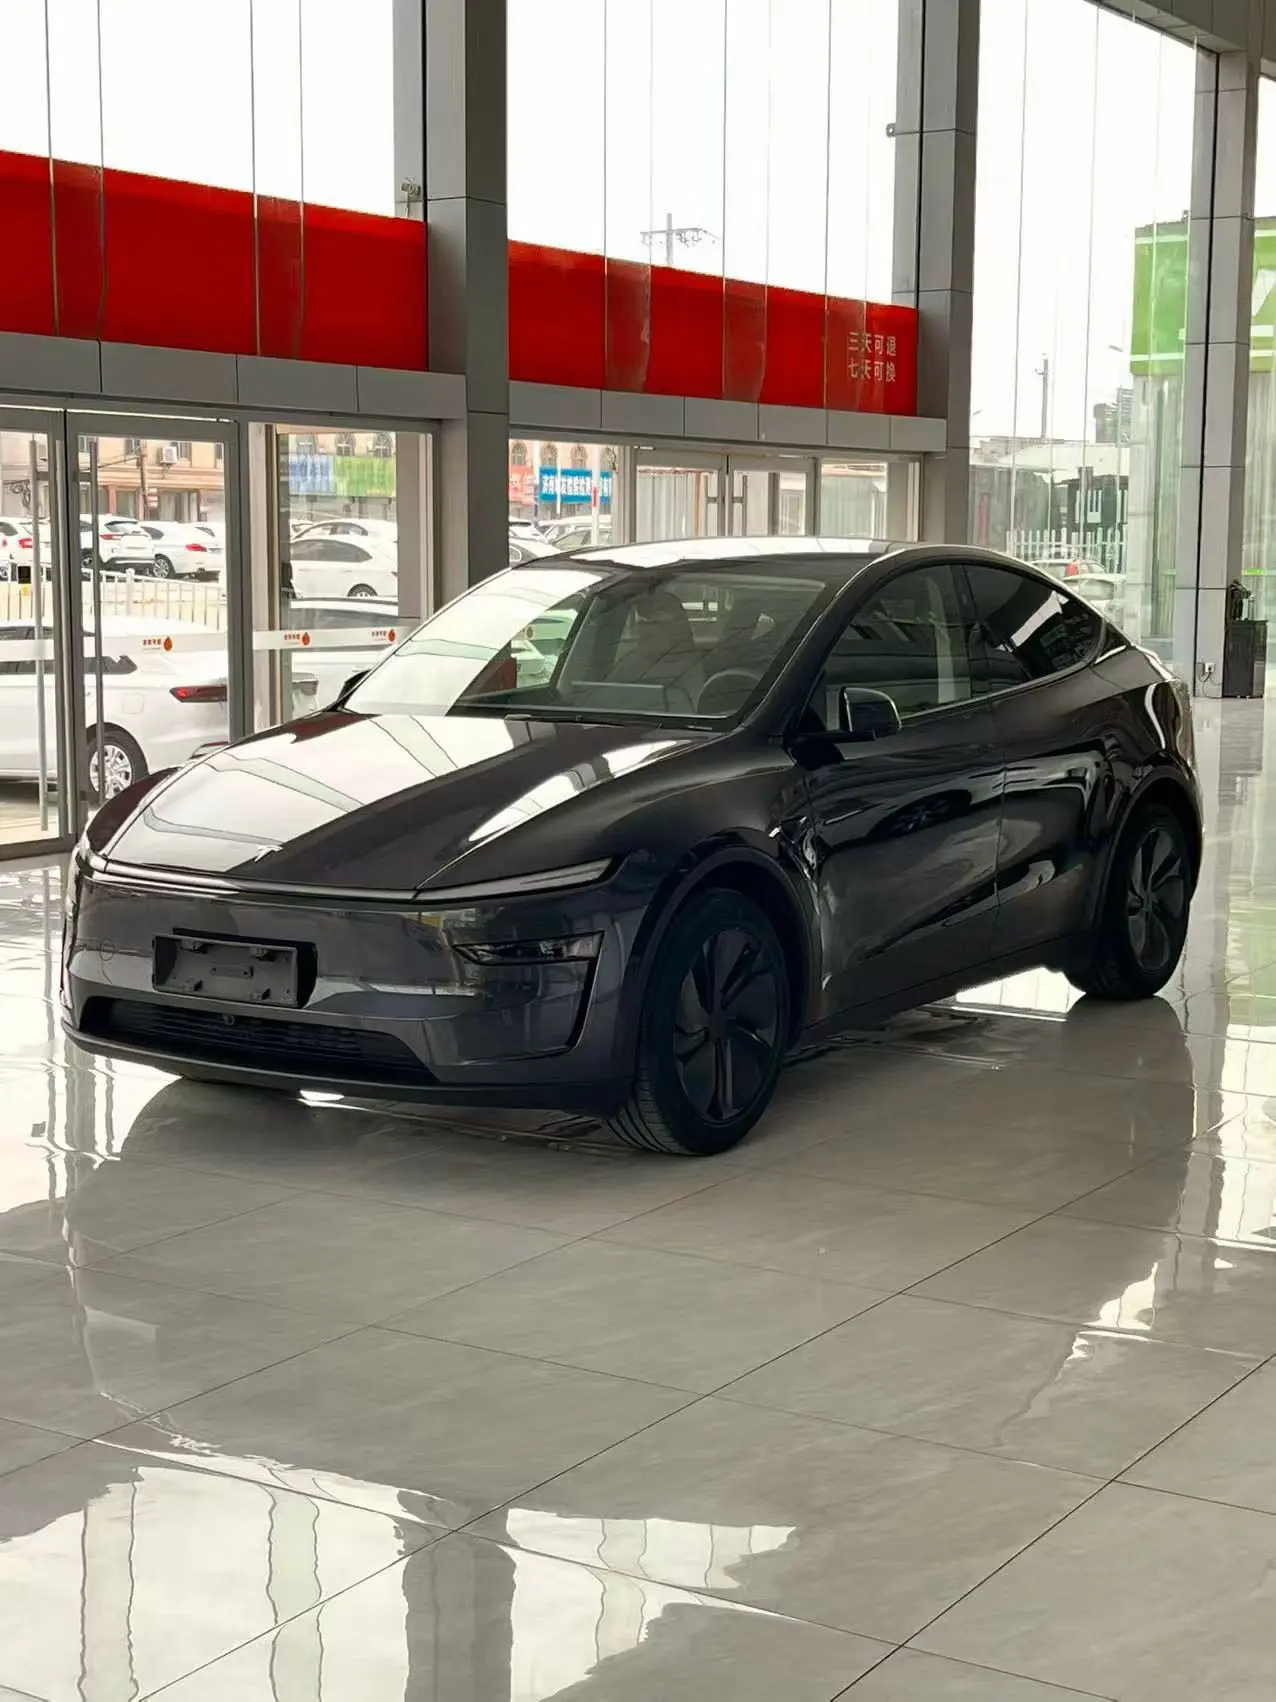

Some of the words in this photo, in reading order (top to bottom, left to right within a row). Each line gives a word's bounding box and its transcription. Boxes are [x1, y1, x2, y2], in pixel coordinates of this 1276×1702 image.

[848, 331, 897, 356] 三天可退
[848, 357, 897, 383] 七天可换
